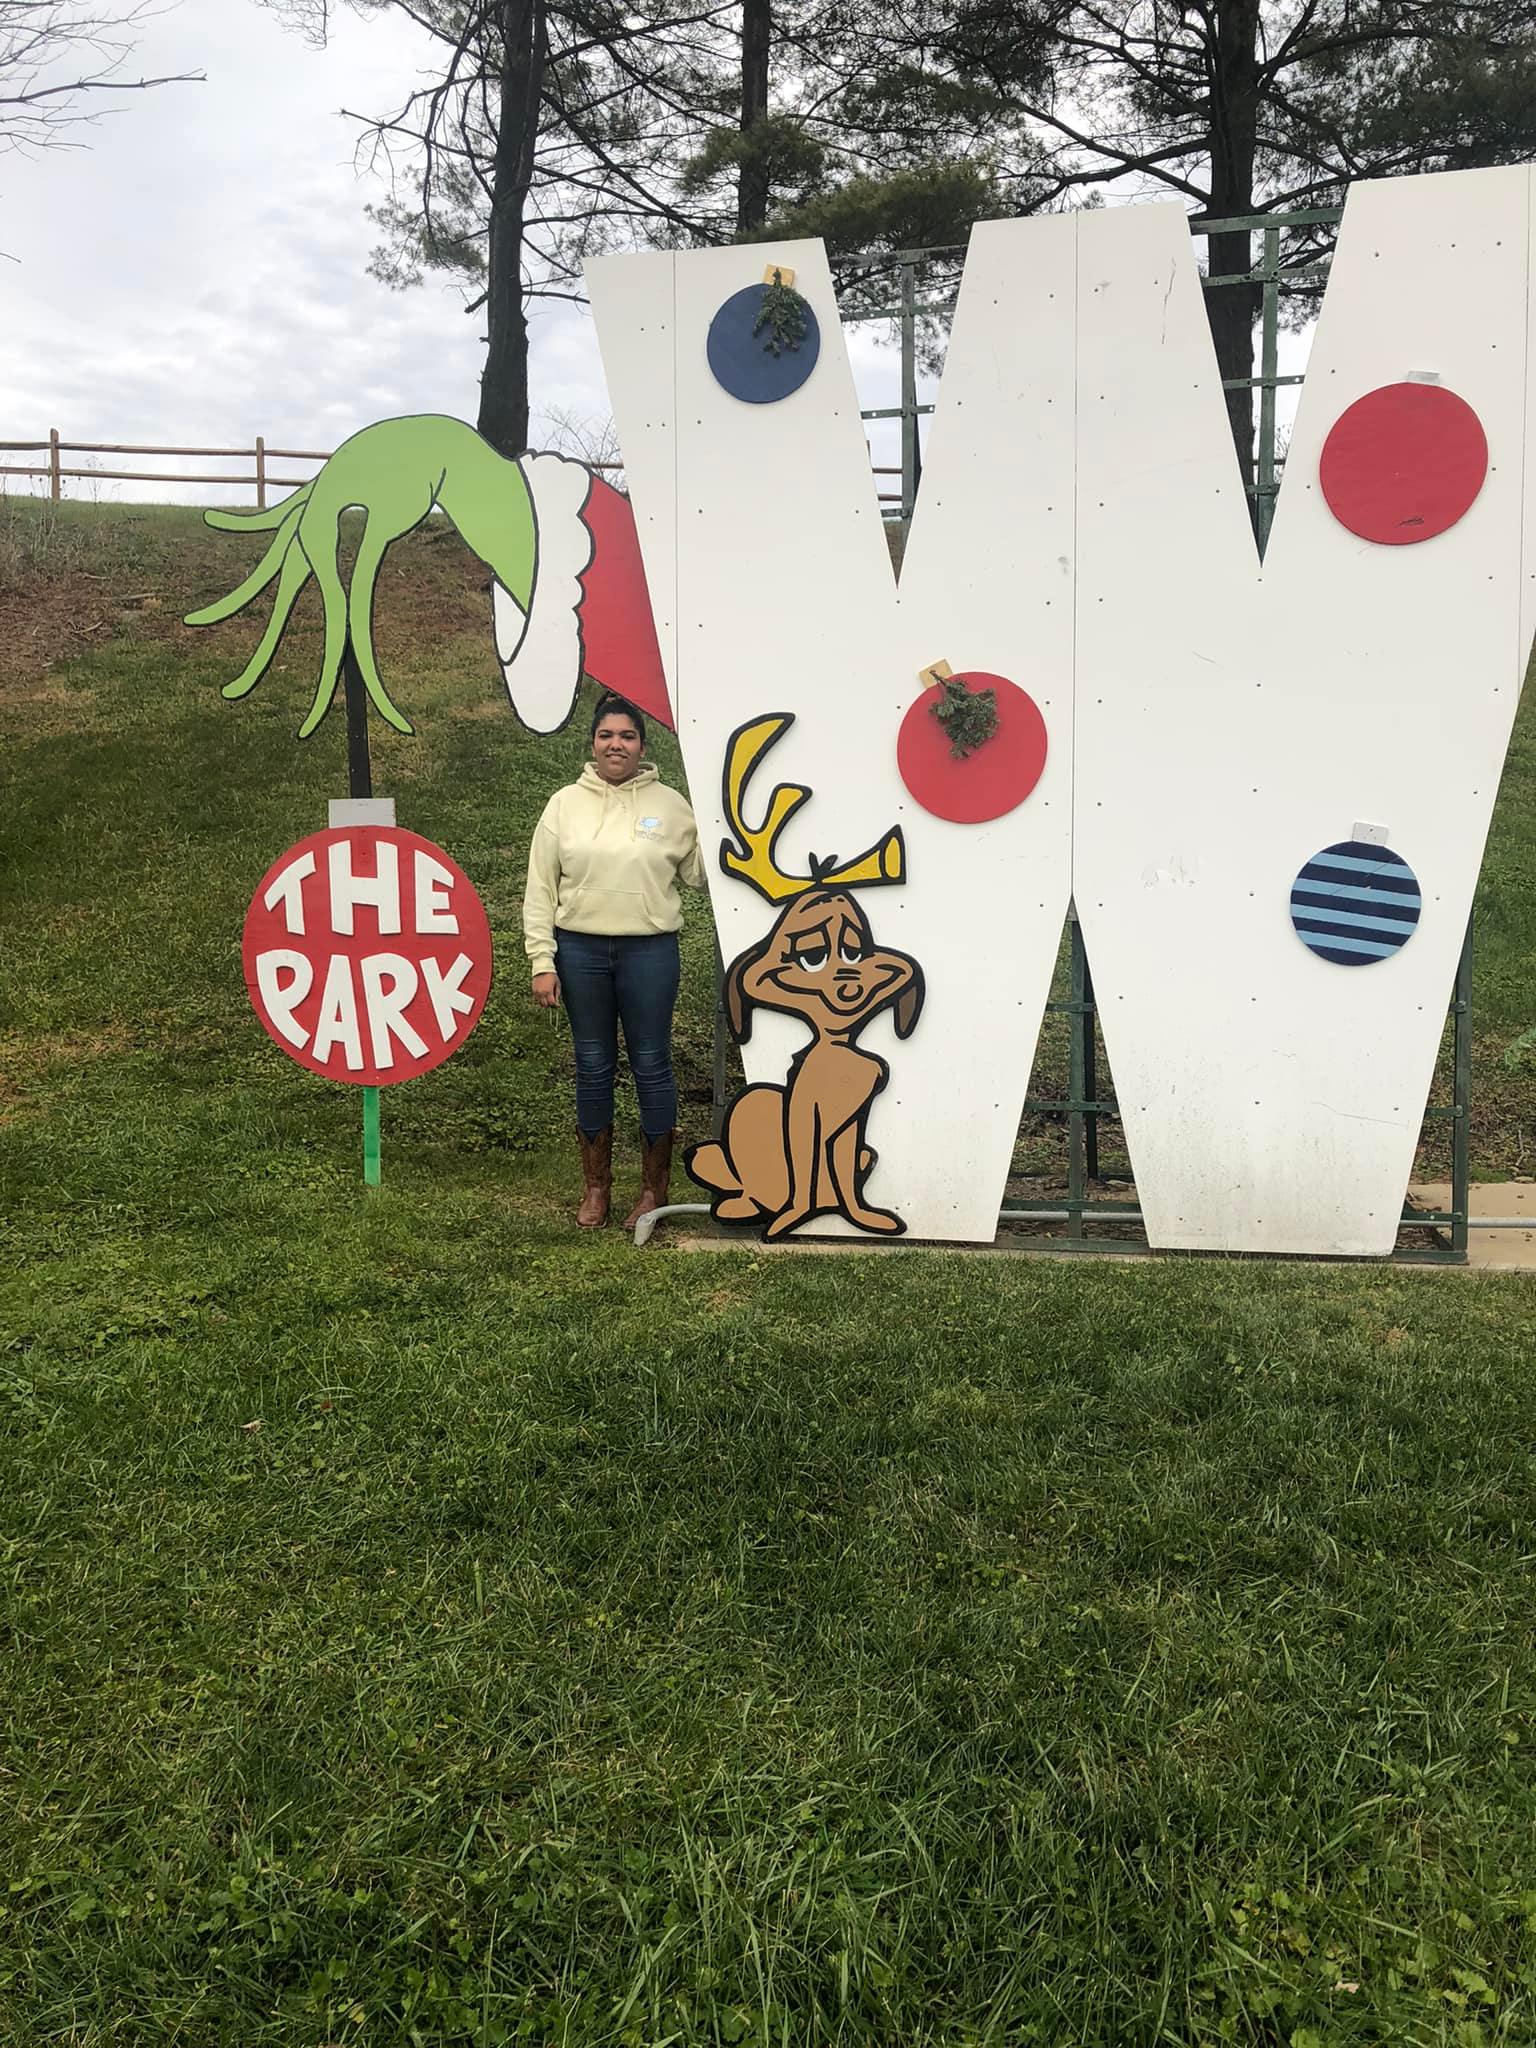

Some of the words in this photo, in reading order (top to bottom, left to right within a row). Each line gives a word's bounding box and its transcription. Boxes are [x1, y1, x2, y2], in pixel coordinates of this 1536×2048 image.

[584, 163, 1536, 1257] W
[264, 840, 460, 936] THE
[256, 949, 475, 1070] PARK
